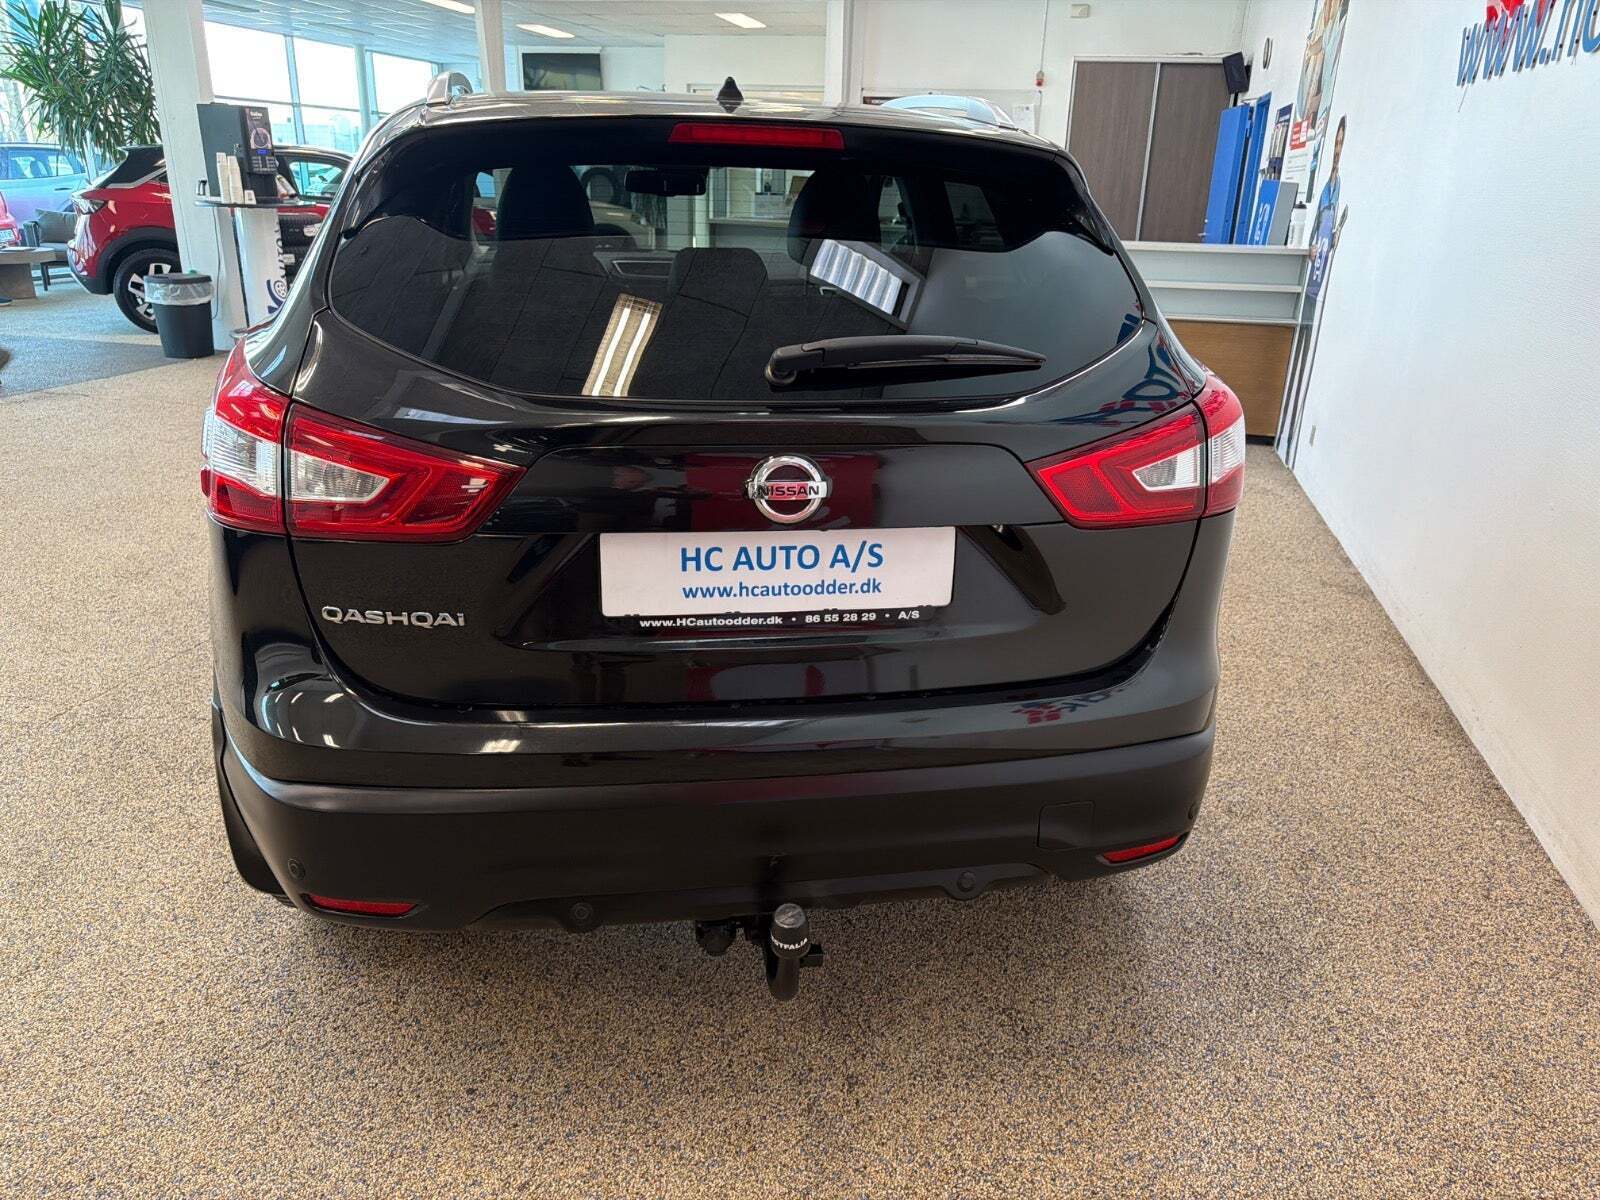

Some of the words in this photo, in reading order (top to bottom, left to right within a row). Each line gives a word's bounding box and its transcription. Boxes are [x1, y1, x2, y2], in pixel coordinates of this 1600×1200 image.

[758, 485, 820, 497] NISSAN
[681, 547, 724, 572] HC
[732, 545, 820, 571] AUTO
[829, 541, 884, 573] A/S
[683, 578, 882, 599] www.hcautoodder.dk
[639, 616, 783, 628] www.HCautoodder.dk
[805, 614, 821, 624] 86
[823, 613, 840, 623] 55
[842, 612, 859, 622] 28
[861, 612, 877, 622] 29
[898, 610, 920, 620] A/S
